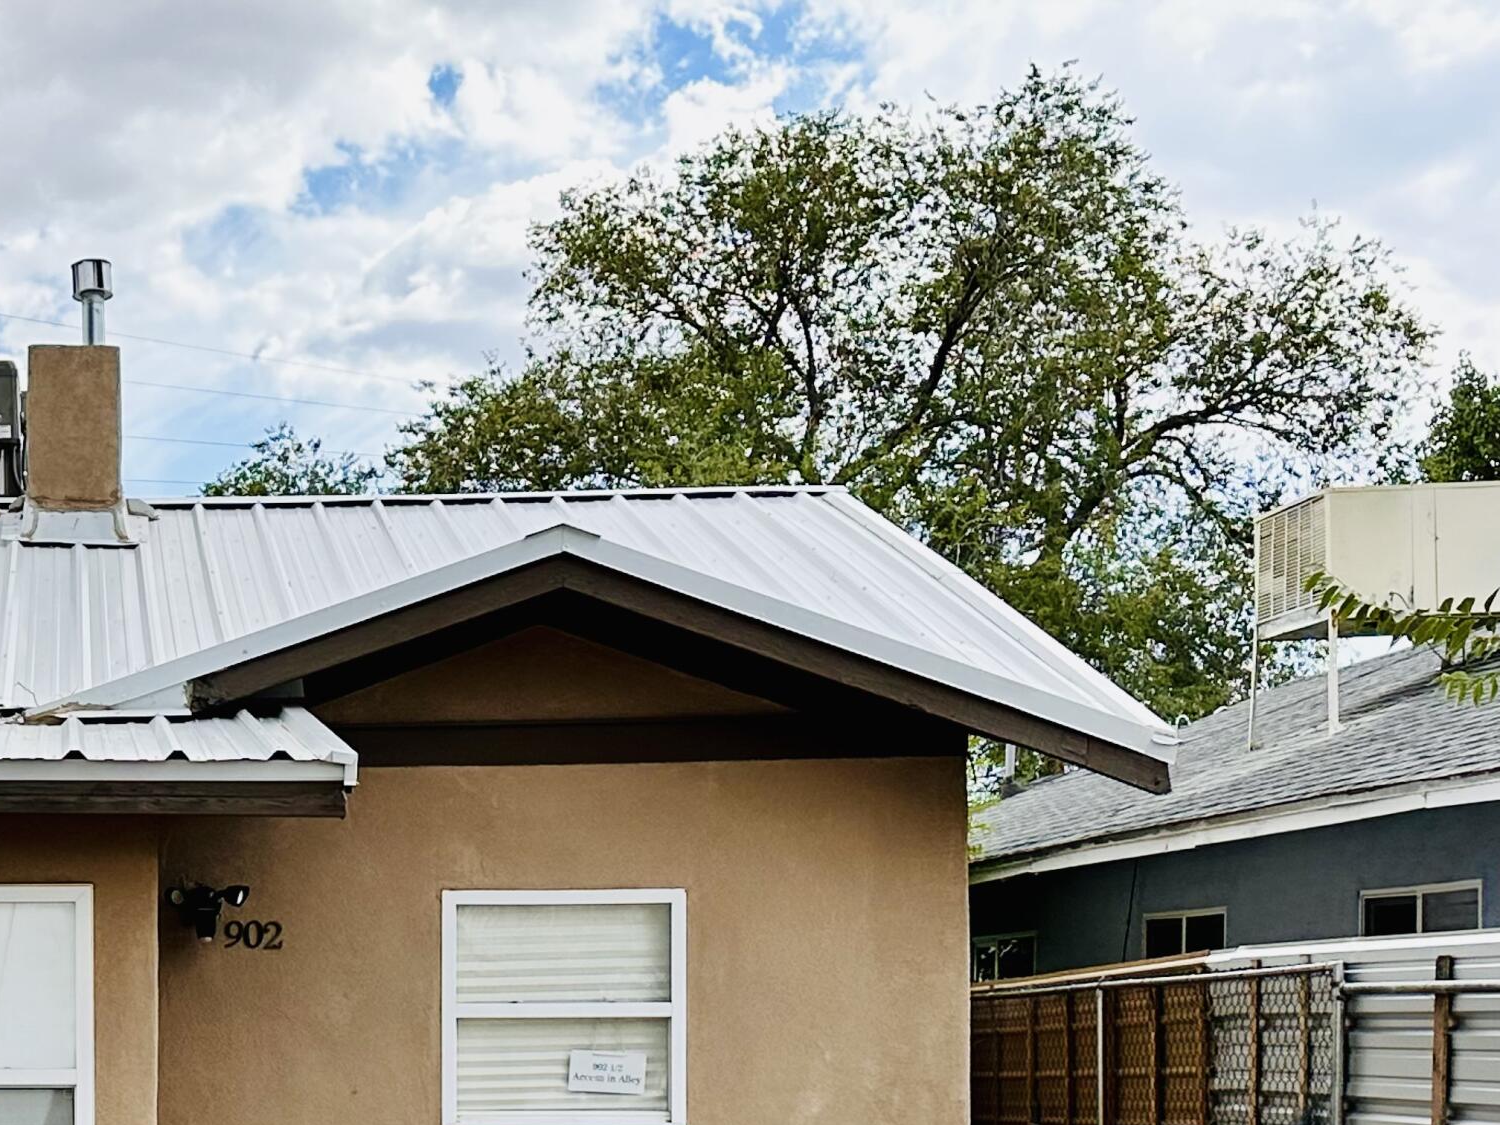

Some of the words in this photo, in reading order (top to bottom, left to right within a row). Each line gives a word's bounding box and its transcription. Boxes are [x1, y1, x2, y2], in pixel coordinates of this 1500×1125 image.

[223, 920, 283, 950] 902
[607, 1073, 617, 1083] in
[619, 1074, 641, 1086] Alley
